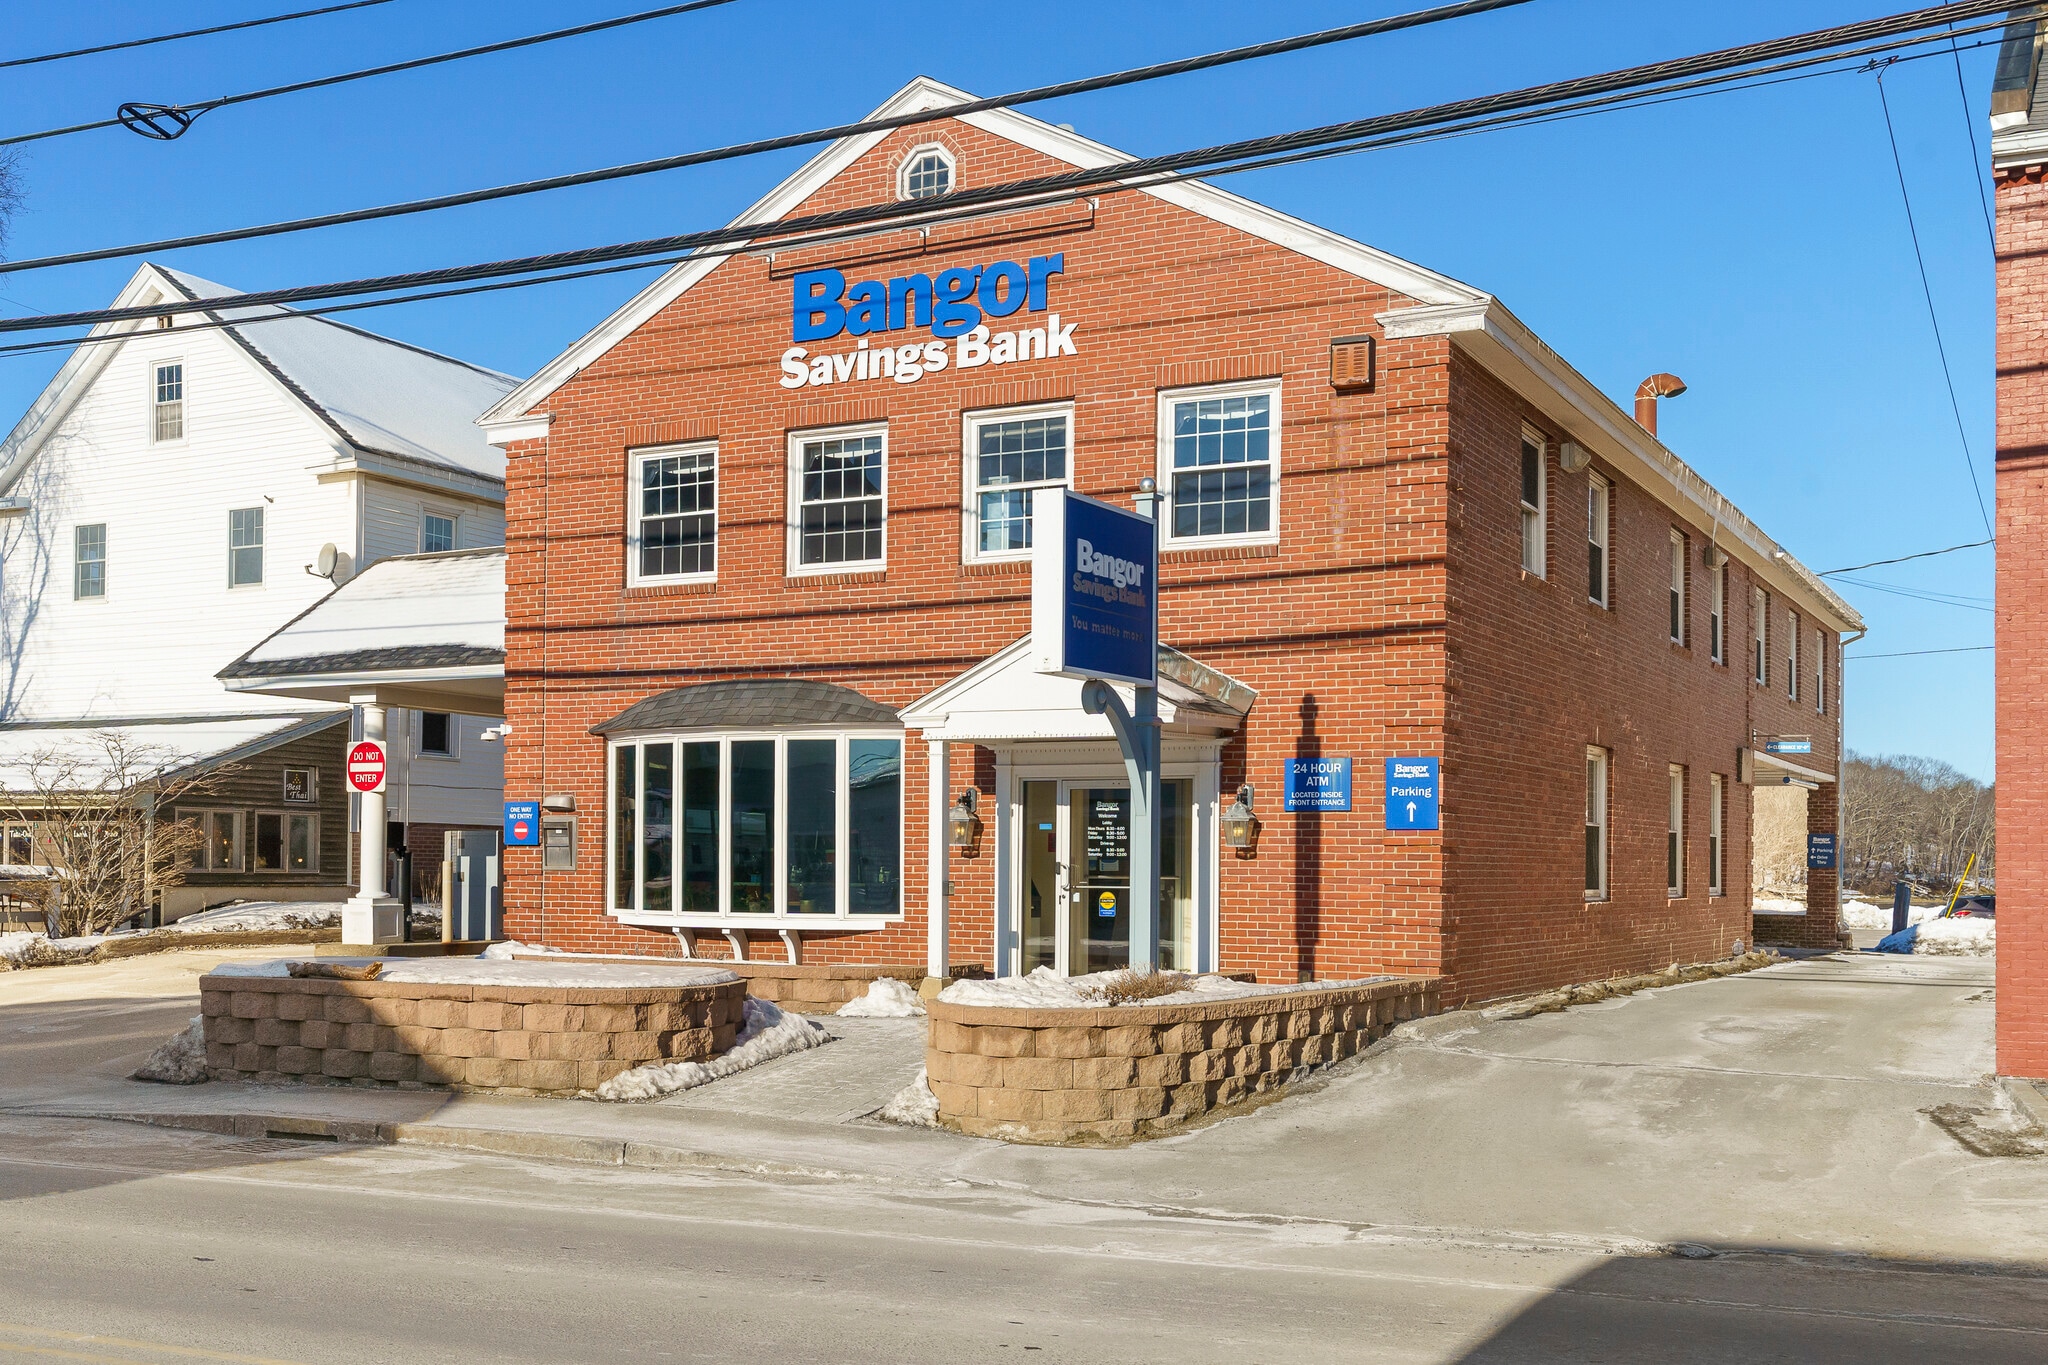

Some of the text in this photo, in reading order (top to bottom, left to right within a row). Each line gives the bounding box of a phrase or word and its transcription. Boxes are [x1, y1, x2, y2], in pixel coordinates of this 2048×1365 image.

[793, 253, 1064, 343] Bangor
[779, 314, 1079, 389] Savings Bank
[1077, 538, 1145, 588] Bangor
[1073, 572, 1146, 608] Savings Bank
[1072, 615, 1089, 631] You
[1092, 623, 1121, 637] matter
[354, 751, 380, 761] DO NOT
[1293, 763, 1342, 774] 24 HOUR
[1395, 764, 1428, 775] Bangor
[355, 774, 377, 783] ENTER
[1306, 776, 1329, 787] ATM
[286, 783, 302, 791] Best
[1391, 786, 1432, 798] Parking
[290, 790, 308, 799] Thai
[1291, 791, 1320, 799] LOCATED
